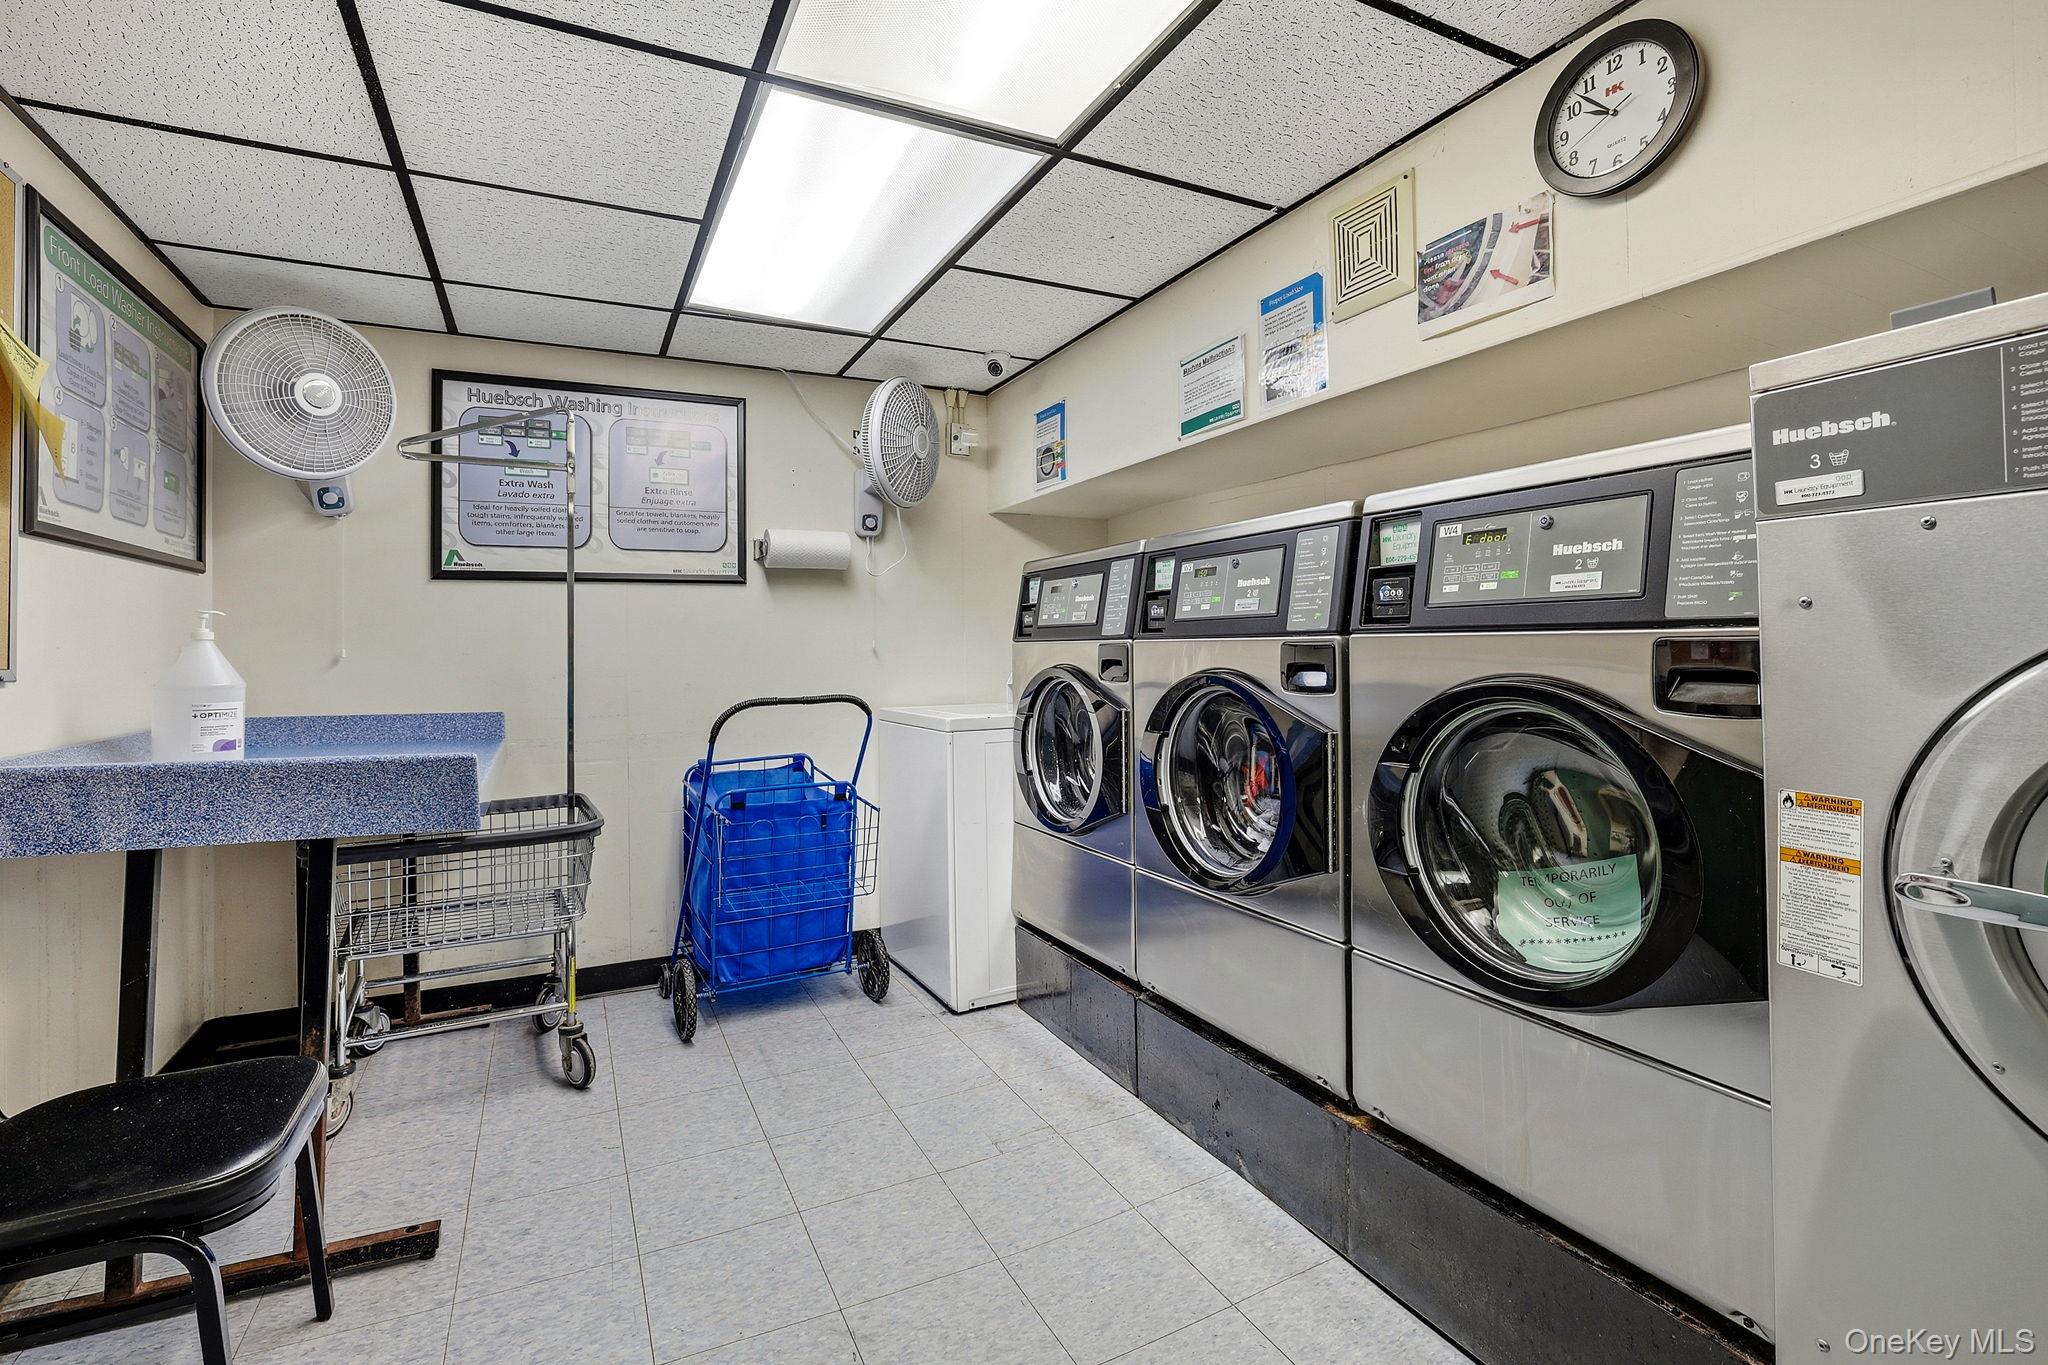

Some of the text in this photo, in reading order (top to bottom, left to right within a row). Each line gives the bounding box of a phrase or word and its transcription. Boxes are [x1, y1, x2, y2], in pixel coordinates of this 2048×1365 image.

[1639, 48, 1647, 66] 1
[1606, 54, 1623, 75] 12
[1656, 55, 1668, 75] 2
[1583, 74, 1596, 95] 11
[1605, 80, 1625, 97] HK
[1667, 77, 1676, 95] 3
[1566, 100, 1582, 121] 10
[1657, 107, 1667, 123] 4
[1560, 130, 1569, 147] 9
[1606, 136, 1627, 149] QUARTZ
[1569, 150, 1579, 167] 8
[1612, 153, 1623, 167] 6
[1588, 157, 1598, 175] 7
[50, 235, 81, 277] Front
[83, 262, 109, 300] Load
[111, 284, 145, 328] Washer
[466, 386, 544, 408] Huebsch
[547, 394, 623, 417] Washing
[1771, 411, 1892, 446] Huebsch
[1809, 454, 1821, 469] 3
[499, 479, 554, 490] Extra Wash
[1794, 485, 1818, 494] Laundry
[1820, 480, 1854, 490] Equipment
[497, 489, 555, 500] Lavado extra
[644, 487, 693, 497] Extra Rinse
[472, 503, 491, 511] Ideal
[504, 505, 530, 513] heavily
[530, 505, 551, 513] soiled
[641, 496, 697, 507] Enjuage extra
[466, 511, 489, 519] tough
[490, 512, 512, 520] stains,
[513, 513, 557, 521] infrequently
[615, 509, 634, 517] Great
[670, 511, 698, 520] blankets,
[698, 513, 721, 521] heavily
[471, 519, 491, 528] items,
[535, 522, 565, 530] blankets
[616, 517, 636, 525] soiled
[636, 518, 660, 526] clothes
[673, 519, 704, 528] customers
[516, 529, 535, 538] large
[684, 528, 702, 536] soap.
[1392, 532, 1416, 543] Laundry
[1443, 526, 1459, 536] W4
[1479, 532, 1508, 544] door
[1552, 538, 1624, 557] Huebsch
[1574, 558, 1583, 570] 2
[1237, 576, 1271, 588] Huebsch
[1247, 589, 1254, 598] 2
[1810, 795, 1853, 807] WARNING
[1802, 850, 1845, 865] WARNING
[1578, 891, 1597, 904] OF
[1545, 914, 1601, 928] SERVICE
